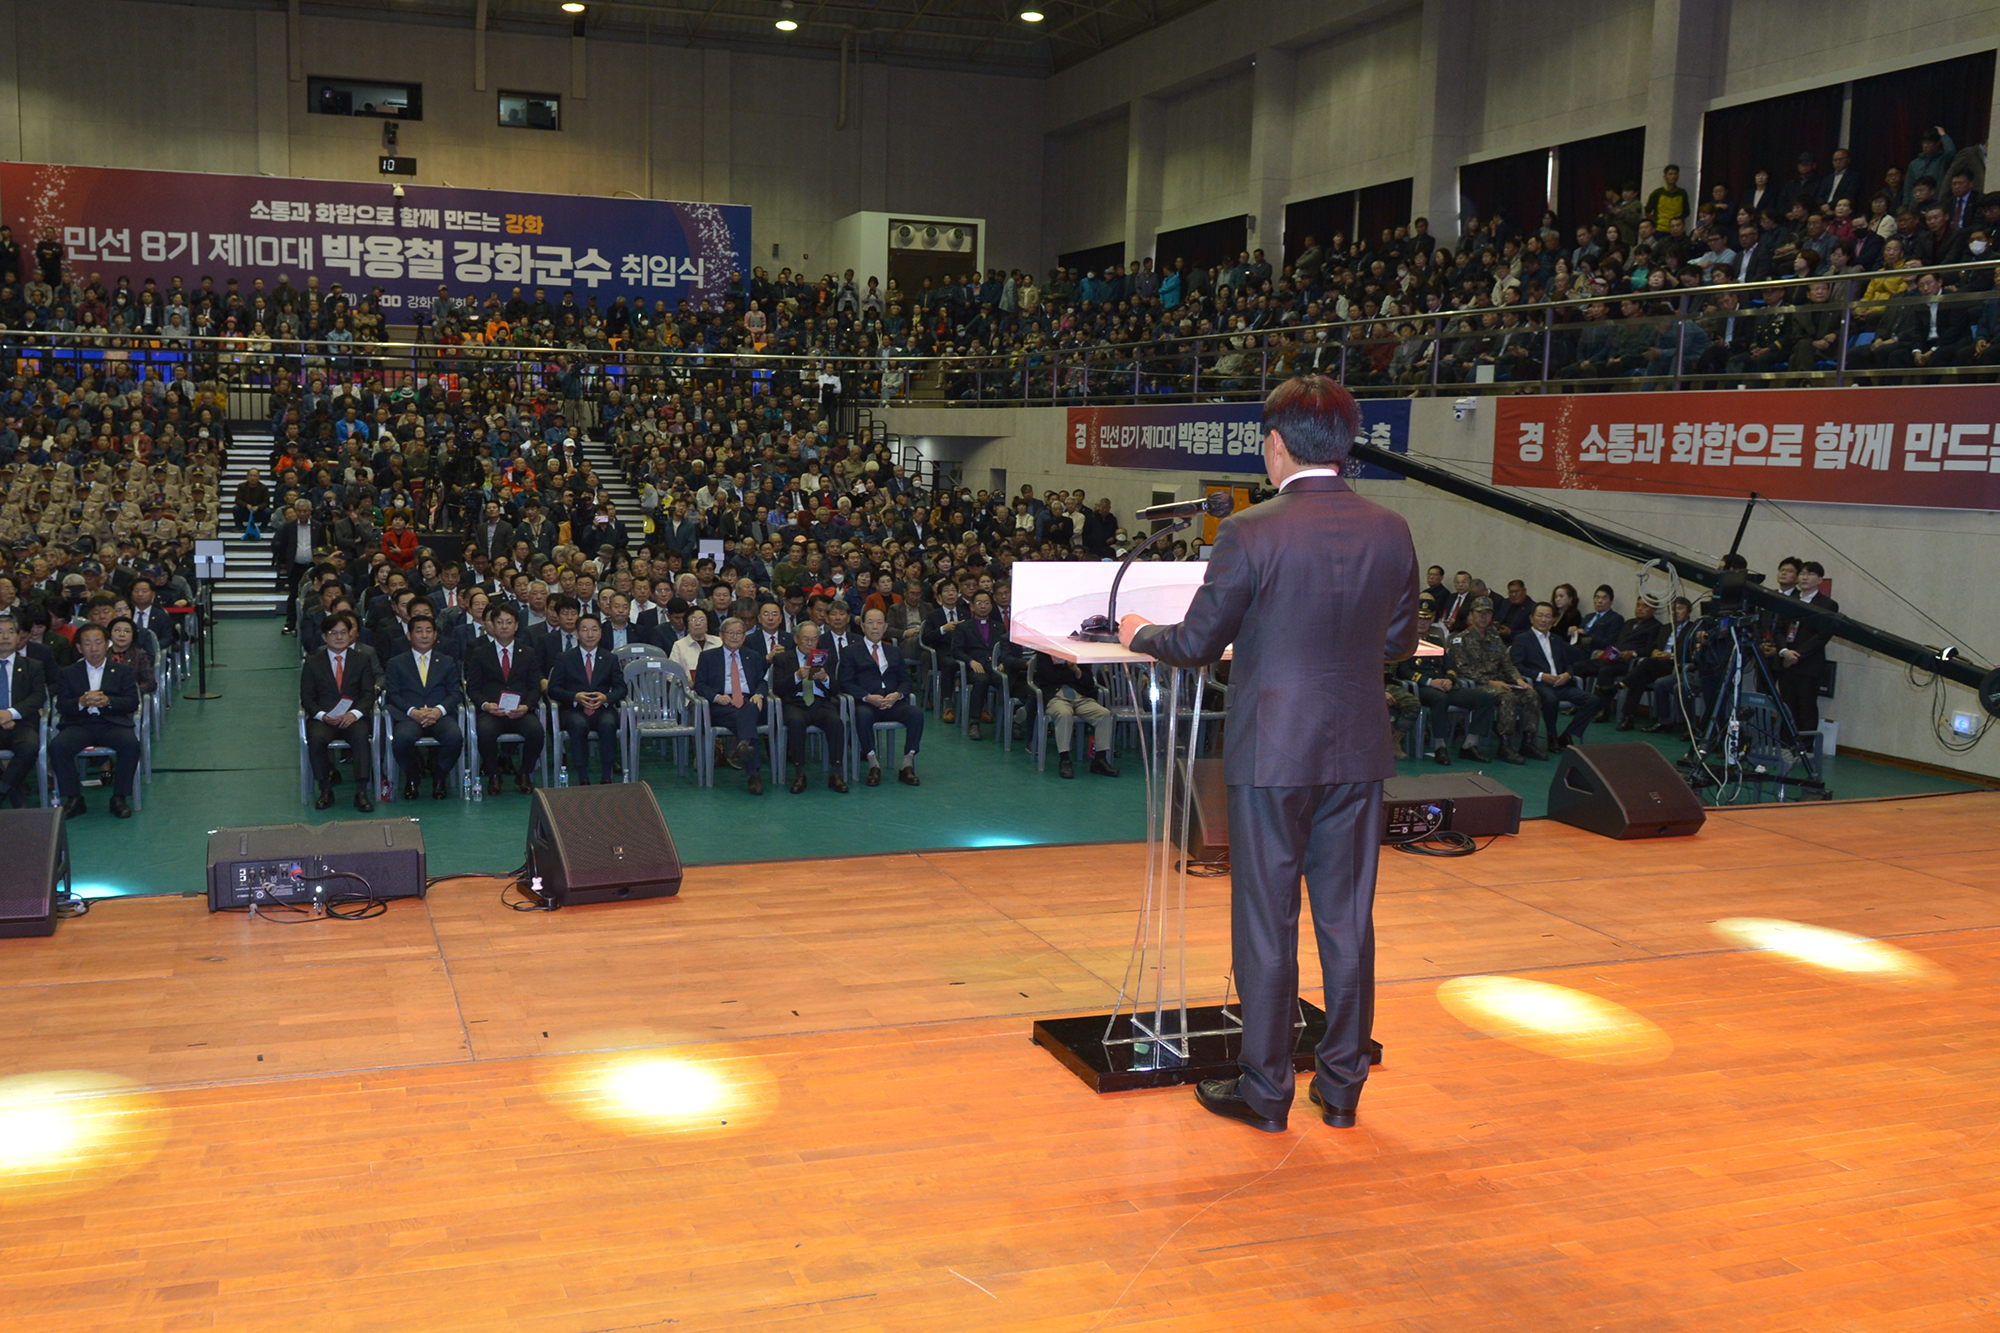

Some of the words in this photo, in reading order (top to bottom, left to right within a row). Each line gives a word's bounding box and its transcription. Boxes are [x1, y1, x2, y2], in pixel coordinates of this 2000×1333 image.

[383, 160, 395, 171] 10
[250, 200, 311, 222] 소통과
[316, 203, 394, 225] 화합으로
[400, 207, 439, 229] 함께
[444, 210, 500, 232] 만드는
[506, 214, 543, 234] 강화
[64, 227, 131, 262] 민선
[141, 231, 198, 265] 8기
[209, 234, 313, 270] 제10대
[322, 235, 443, 279] 박용철
[453, 241, 611, 287] 강화군수
[621, 254, 704, 288] 취임식
[1075, 424, 1086, 448] 경
[1100, 426, 1119, 448] 민선
[1121, 426, 1139, 449] 8기
[1141, 426, 1176, 450] 제10대
[1178, 422, 1224, 454] 박용철
[1519, 423, 1544, 461] 경
[1580, 424, 1665, 464] 소통과
[1671, 422, 1804, 466] 화합으로
[1814, 422, 1894, 470] 함께
[1904, 423, 2000, 473] 만드
